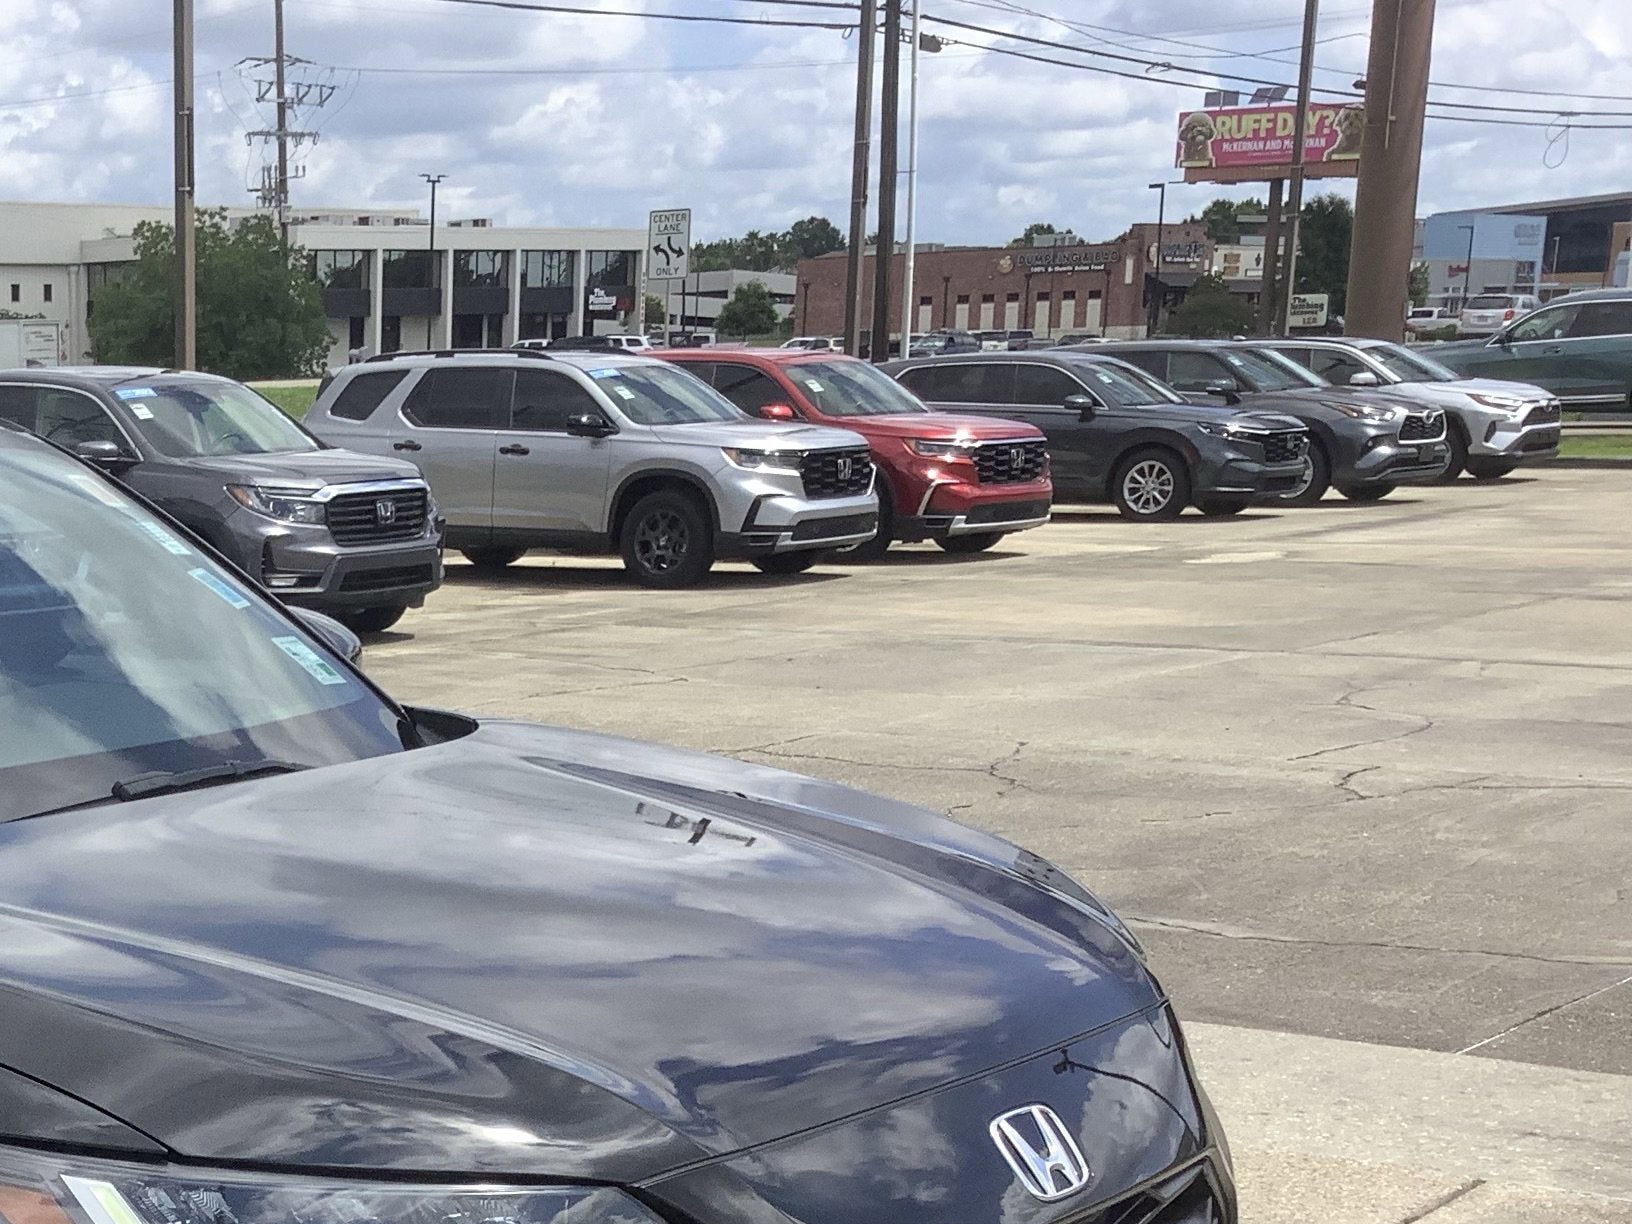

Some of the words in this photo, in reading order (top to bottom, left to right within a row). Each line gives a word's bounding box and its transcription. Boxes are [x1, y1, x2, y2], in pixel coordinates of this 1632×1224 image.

[1216, 113, 1275, 140] RUFF
[1276, 110, 1335, 138] DY?
[1265, 138, 1283, 151] AND
[653, 213, 687, 223] CENTER
[658, 222, 681, 233] LANE
[1018, 251, 1080, 266] DUMPING
[656, 267, 680, 277] ONLY
